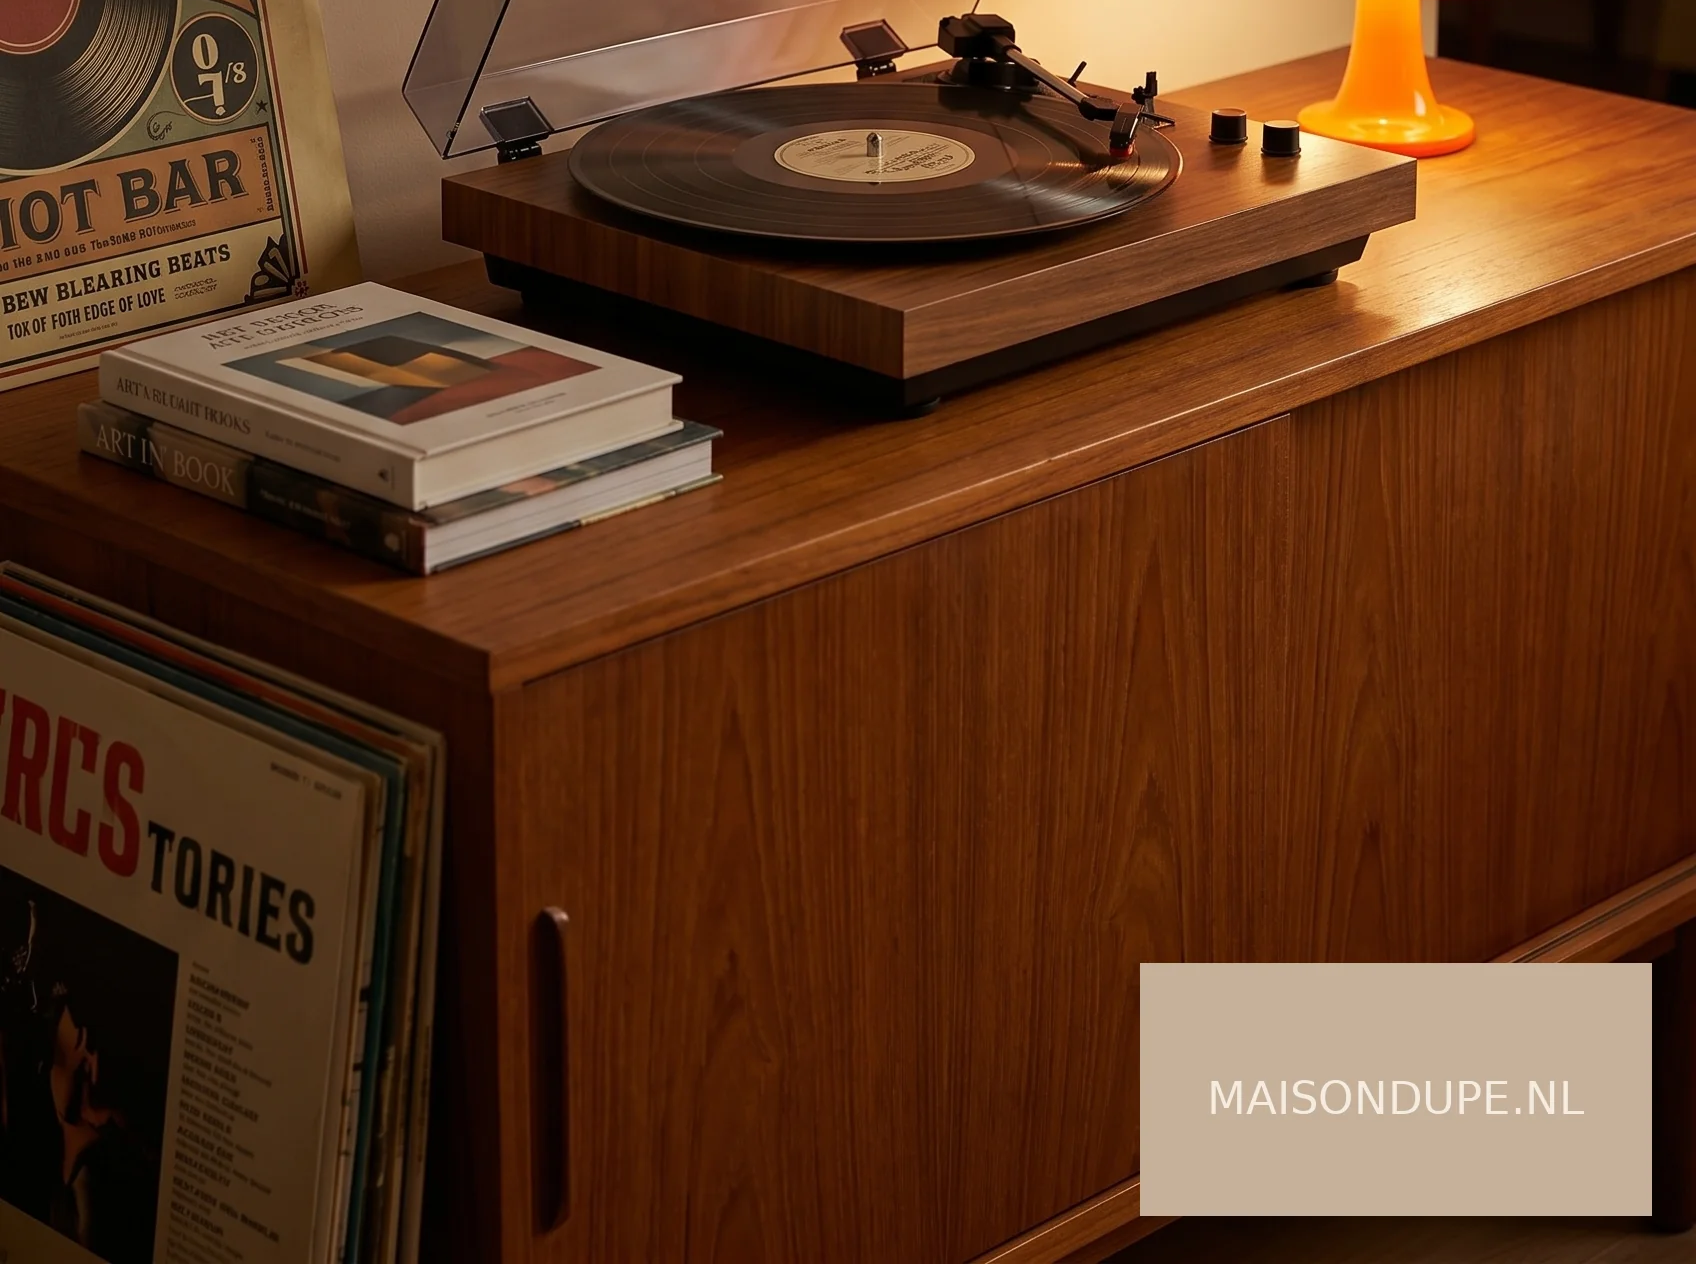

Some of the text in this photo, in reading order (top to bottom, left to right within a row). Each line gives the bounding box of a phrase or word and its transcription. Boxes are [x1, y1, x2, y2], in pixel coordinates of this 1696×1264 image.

[117, 149, 248, 222] BAR
[1, 286, 49, 314] BEW
[56, 259, 161, 302] BLEARING
[167, 243, 231, 275] BEATS
[7, 321, 30, 341] TOX
[32, 316, 47, 333] OF
[51, 309, 81, 330] FOTH
[84, 300, 116, 322] EDGE
[119, 295, 134, 313] OF
[137, 287, 166, 309] LOVE
[96, 424, 136, 458] ART
[173, 450, 235, 496] BOOK
[0, 687, 146, 878] RCS
